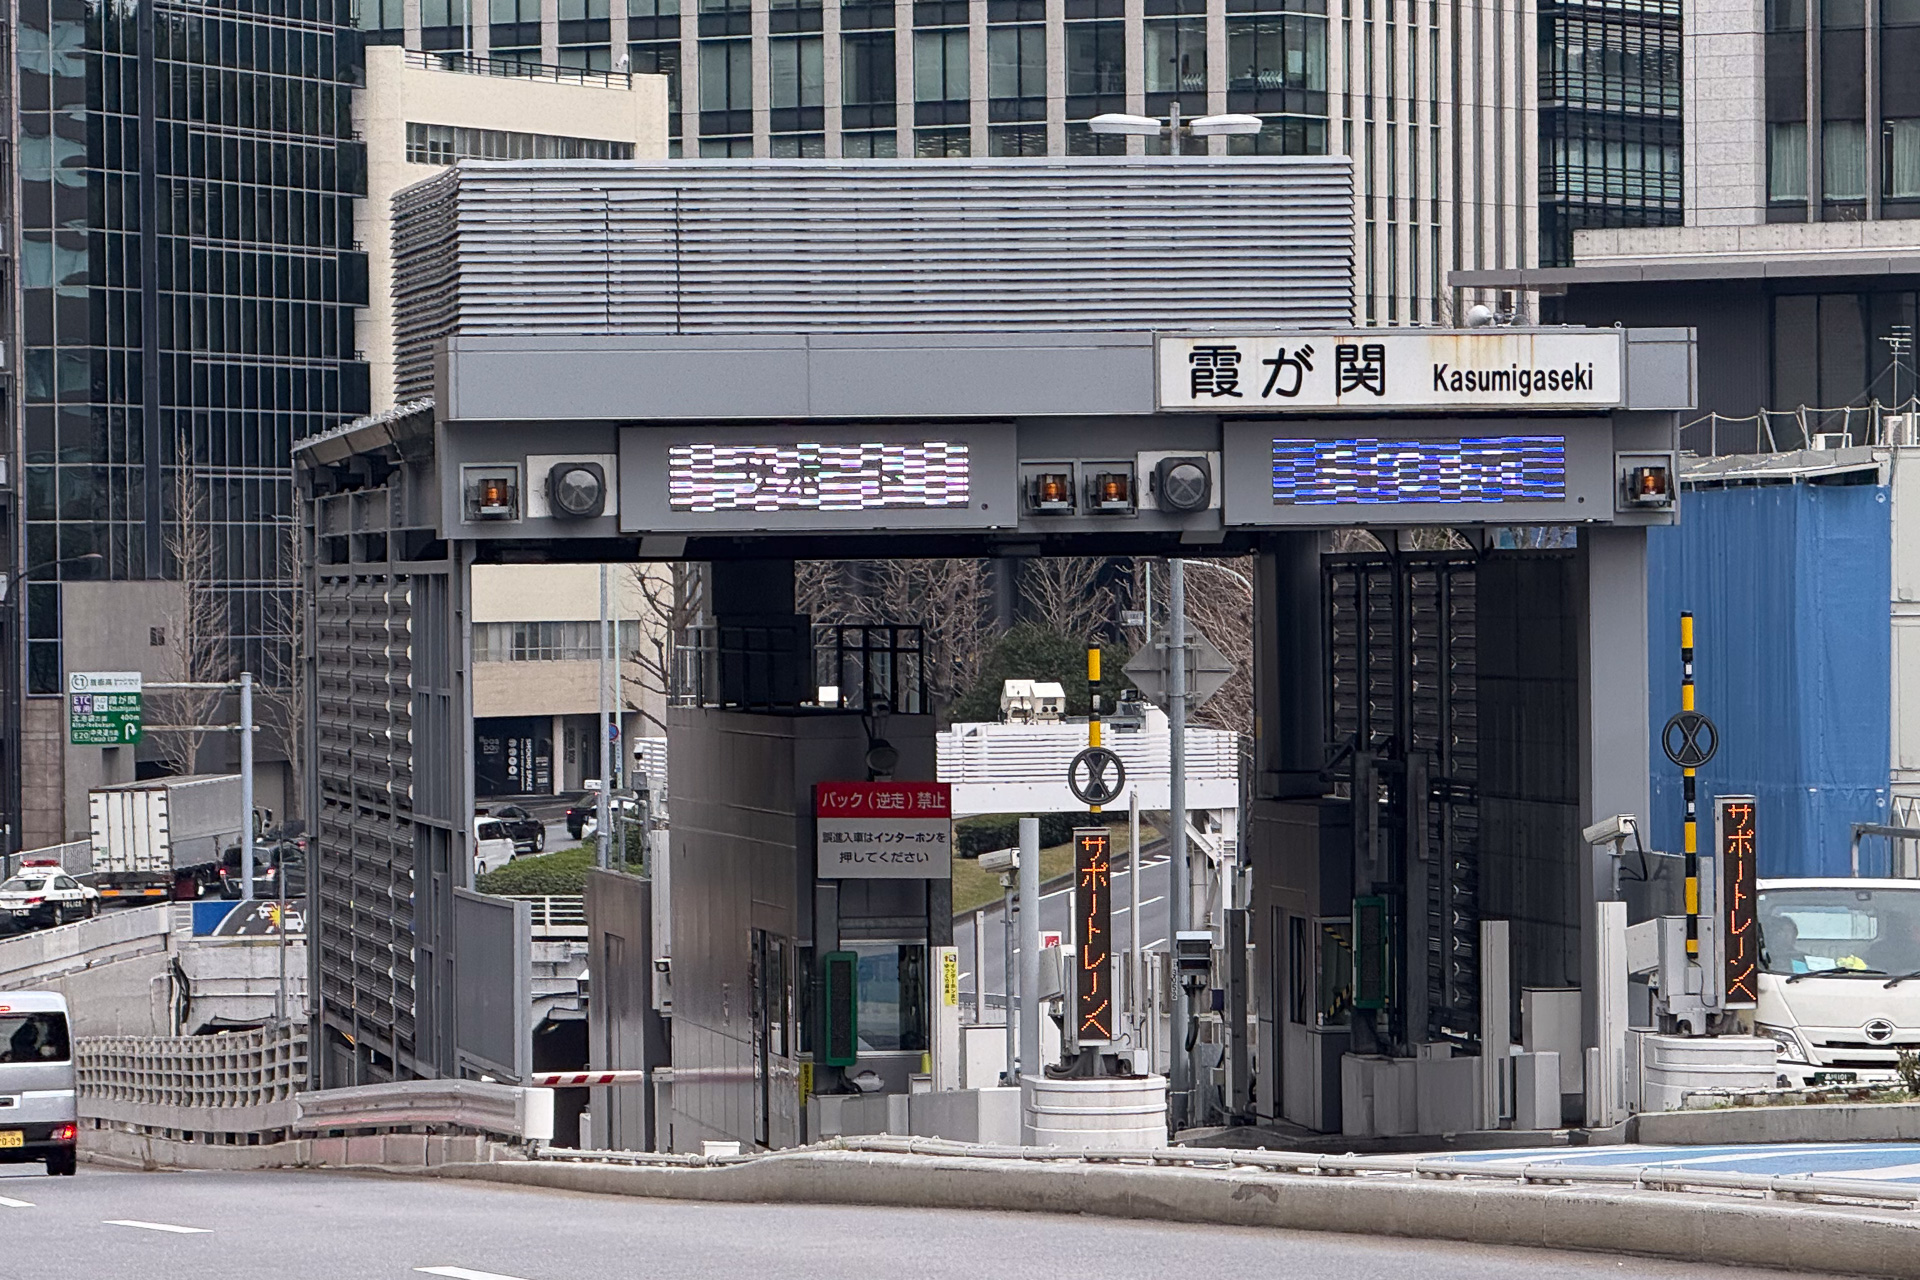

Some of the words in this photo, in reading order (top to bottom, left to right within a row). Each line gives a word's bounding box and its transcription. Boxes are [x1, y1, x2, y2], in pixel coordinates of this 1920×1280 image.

[1188, 344, 1387, 399] 霞が関
[1432, 362, 1594, 397] Kasumigaseki
[73, 696, 90, 704] ETC
[822, 831, 947, 844] 誤進入車はインターホンを
[839, 851, 930, 864] 押してください
[0, 1137, 21, 1146] 0-09
